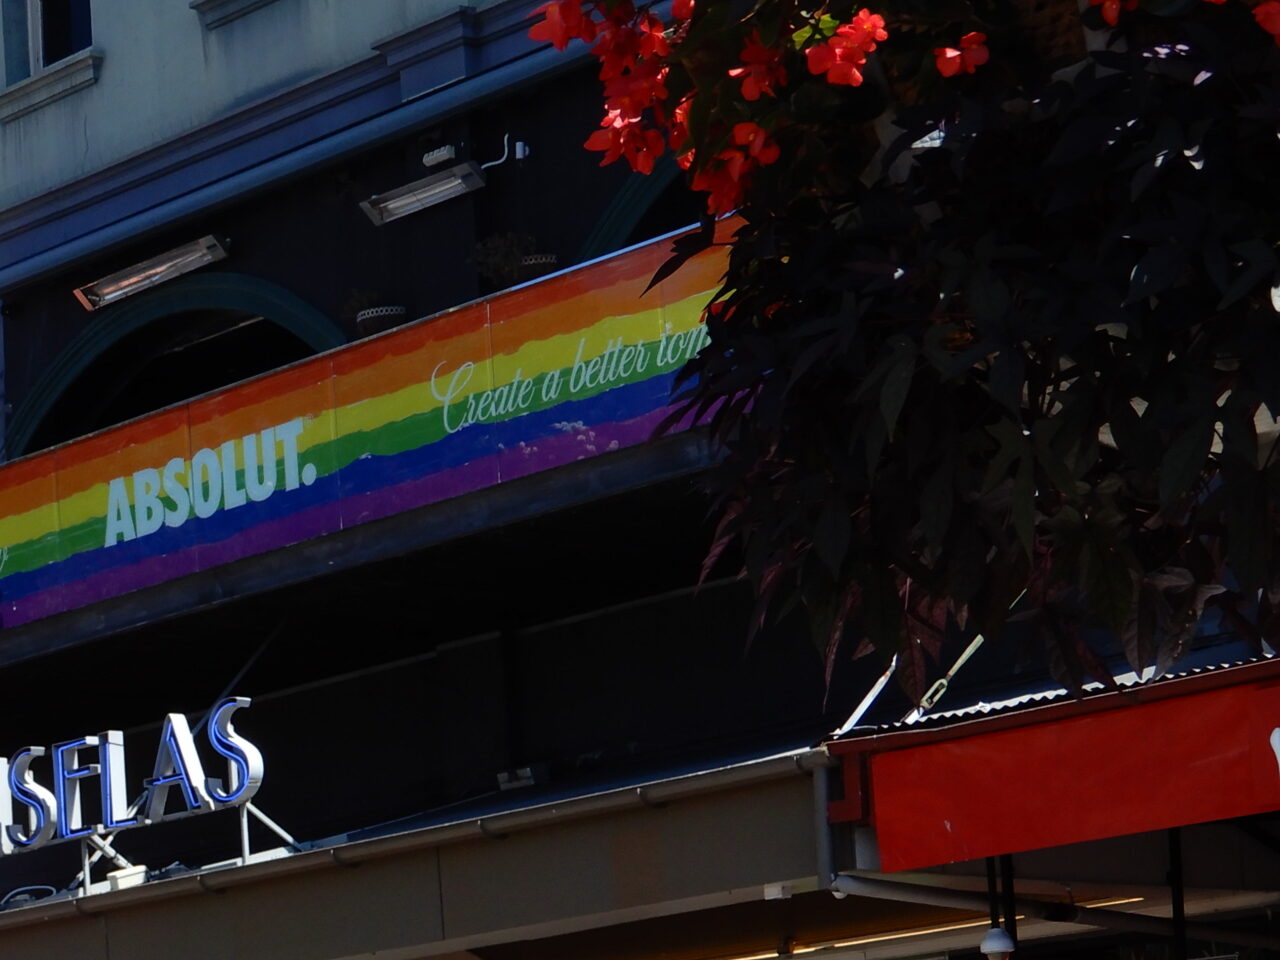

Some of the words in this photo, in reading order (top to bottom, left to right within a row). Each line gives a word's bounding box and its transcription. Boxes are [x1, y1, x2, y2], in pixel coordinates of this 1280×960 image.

[431, 360, 535, 433] Create
[542, 370, 566, 401] a
[570, 337, 650, 393] better
